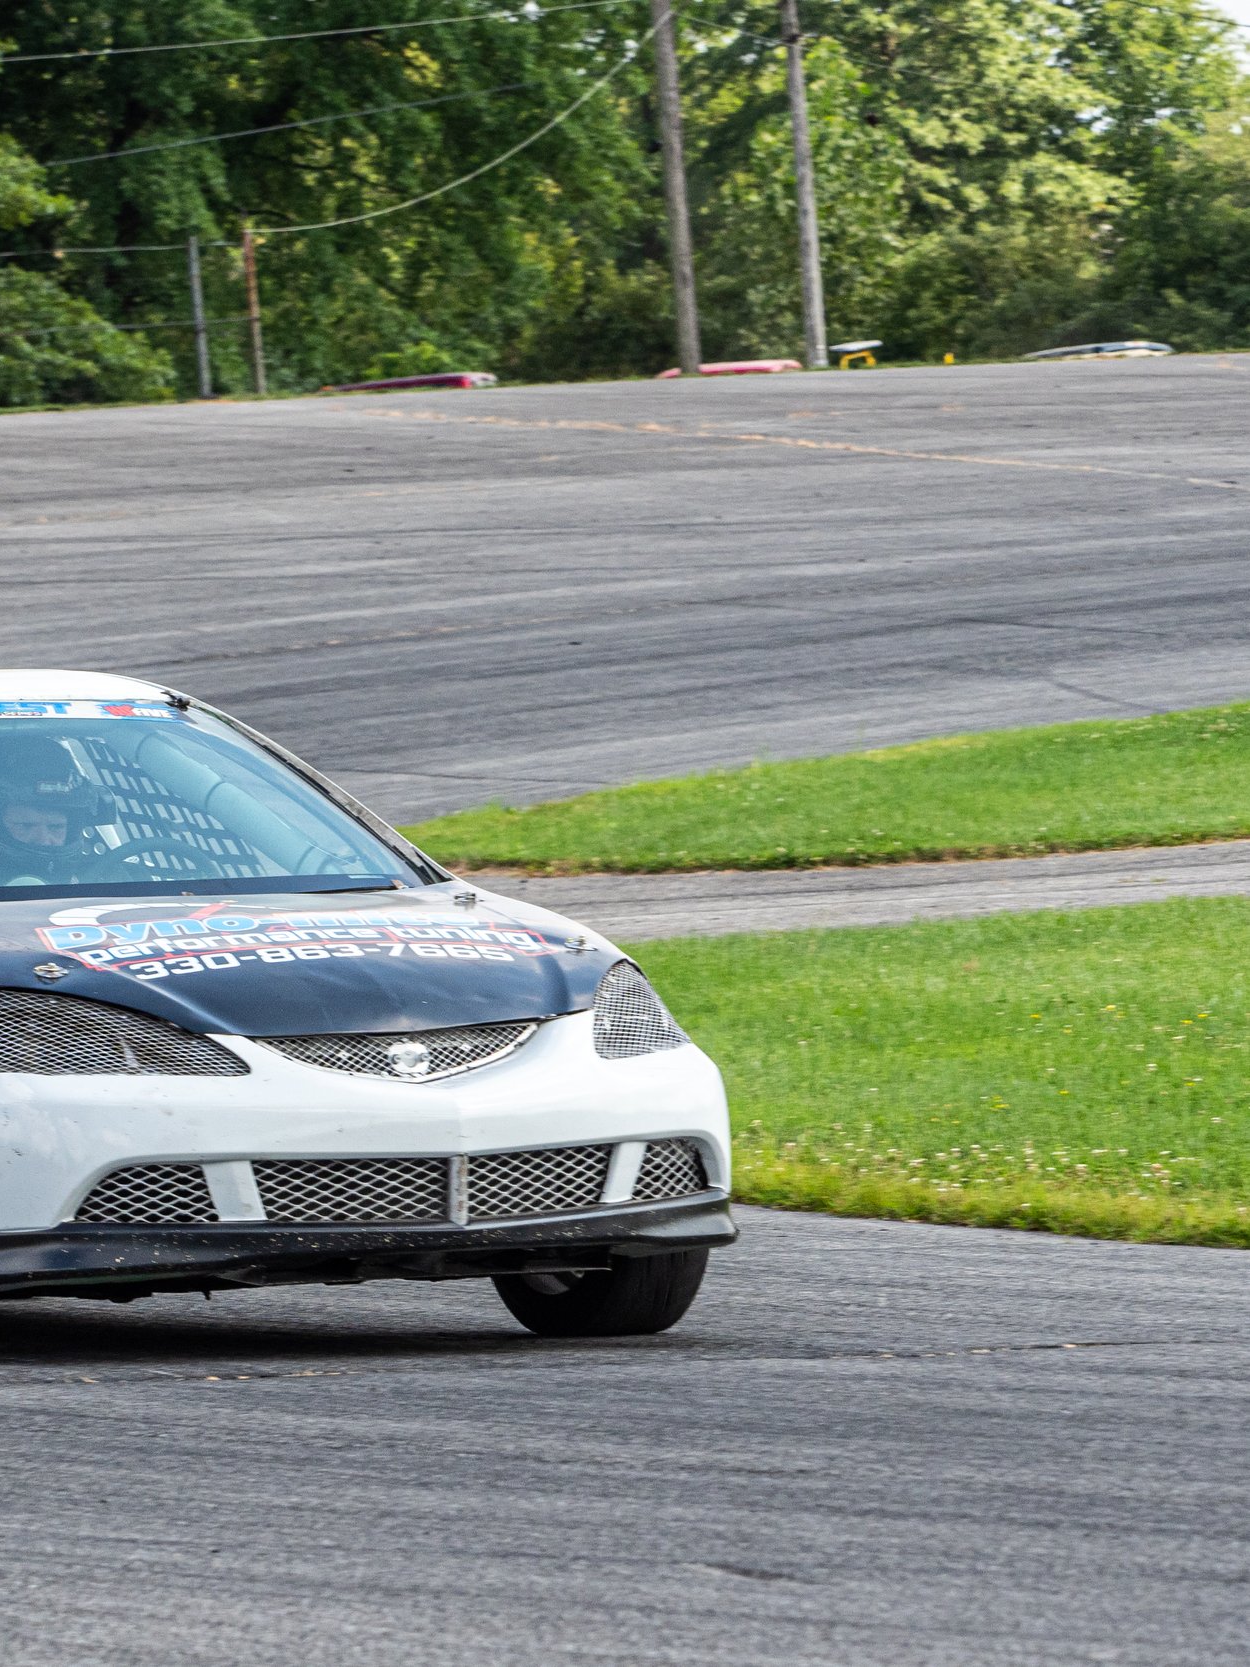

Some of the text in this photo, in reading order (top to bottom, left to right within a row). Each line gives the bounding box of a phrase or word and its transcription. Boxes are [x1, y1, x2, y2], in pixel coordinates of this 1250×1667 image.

[78, 925, 545, 965] performance tuning
[129, 942, 516, 980] 330-863-7665
